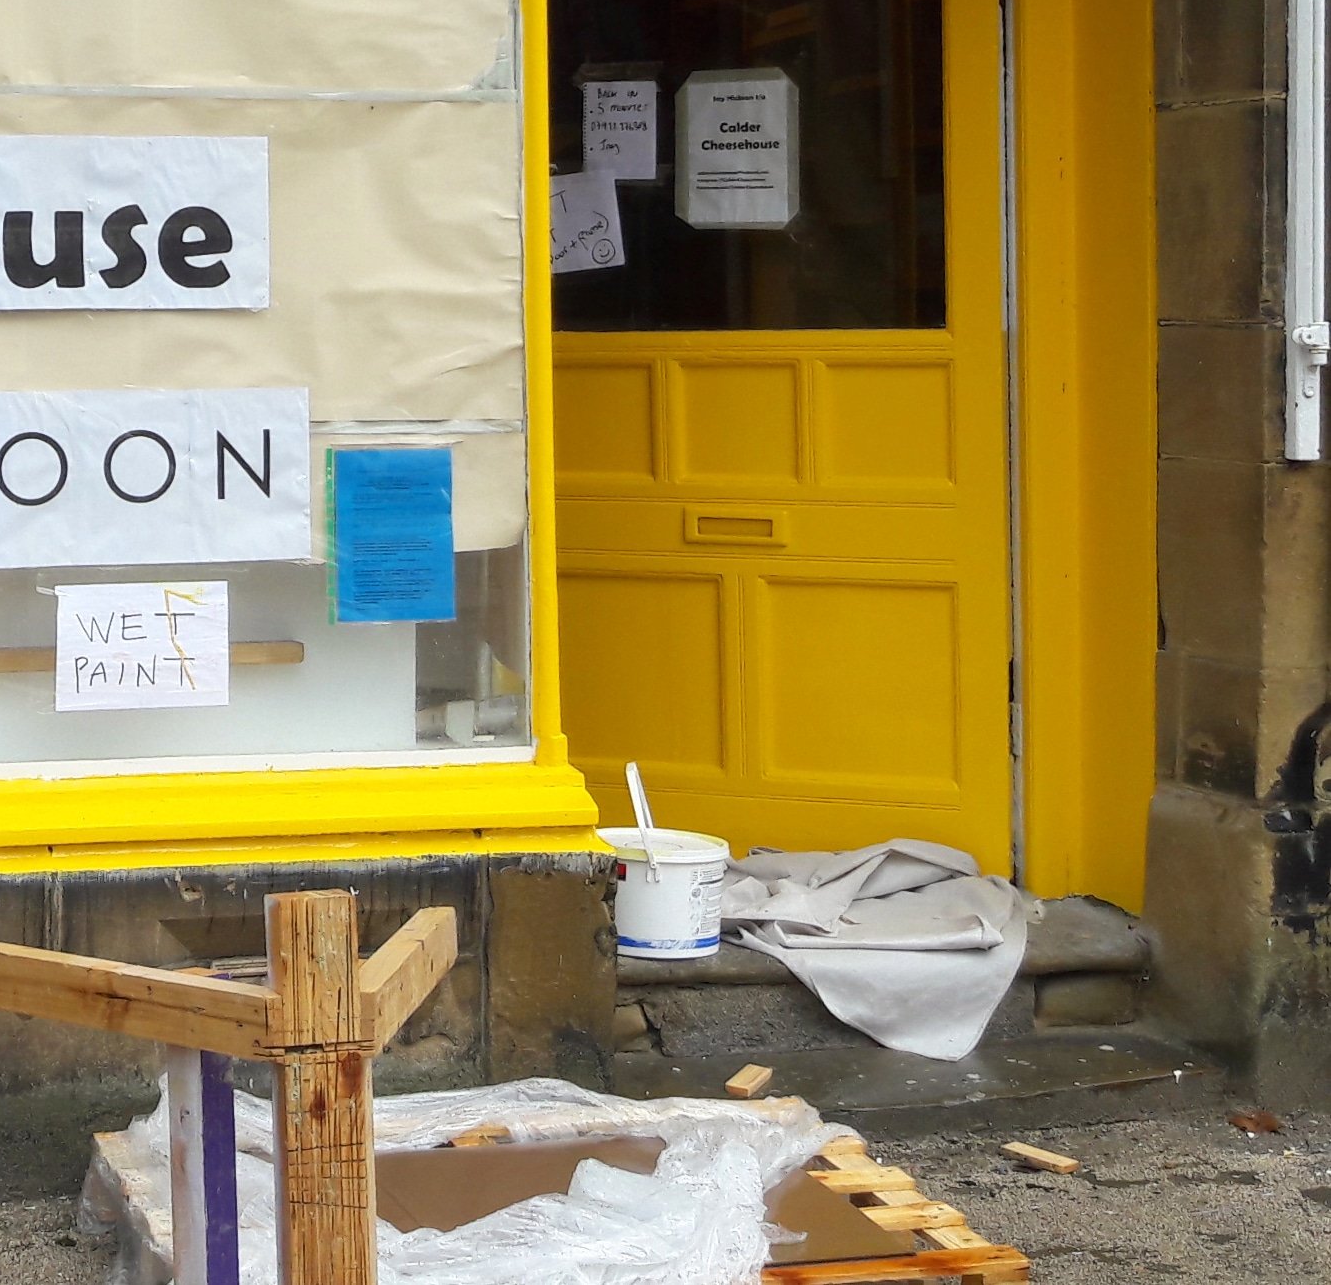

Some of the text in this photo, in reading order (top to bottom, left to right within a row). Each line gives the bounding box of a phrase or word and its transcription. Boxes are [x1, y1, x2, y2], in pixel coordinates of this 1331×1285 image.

[719, 122, 761, 133] Calder
[701, 139, 780, 151] Cheesehouse
[75, 612, 196, 644] WET
[74, 654, 196, 693] PAINT
